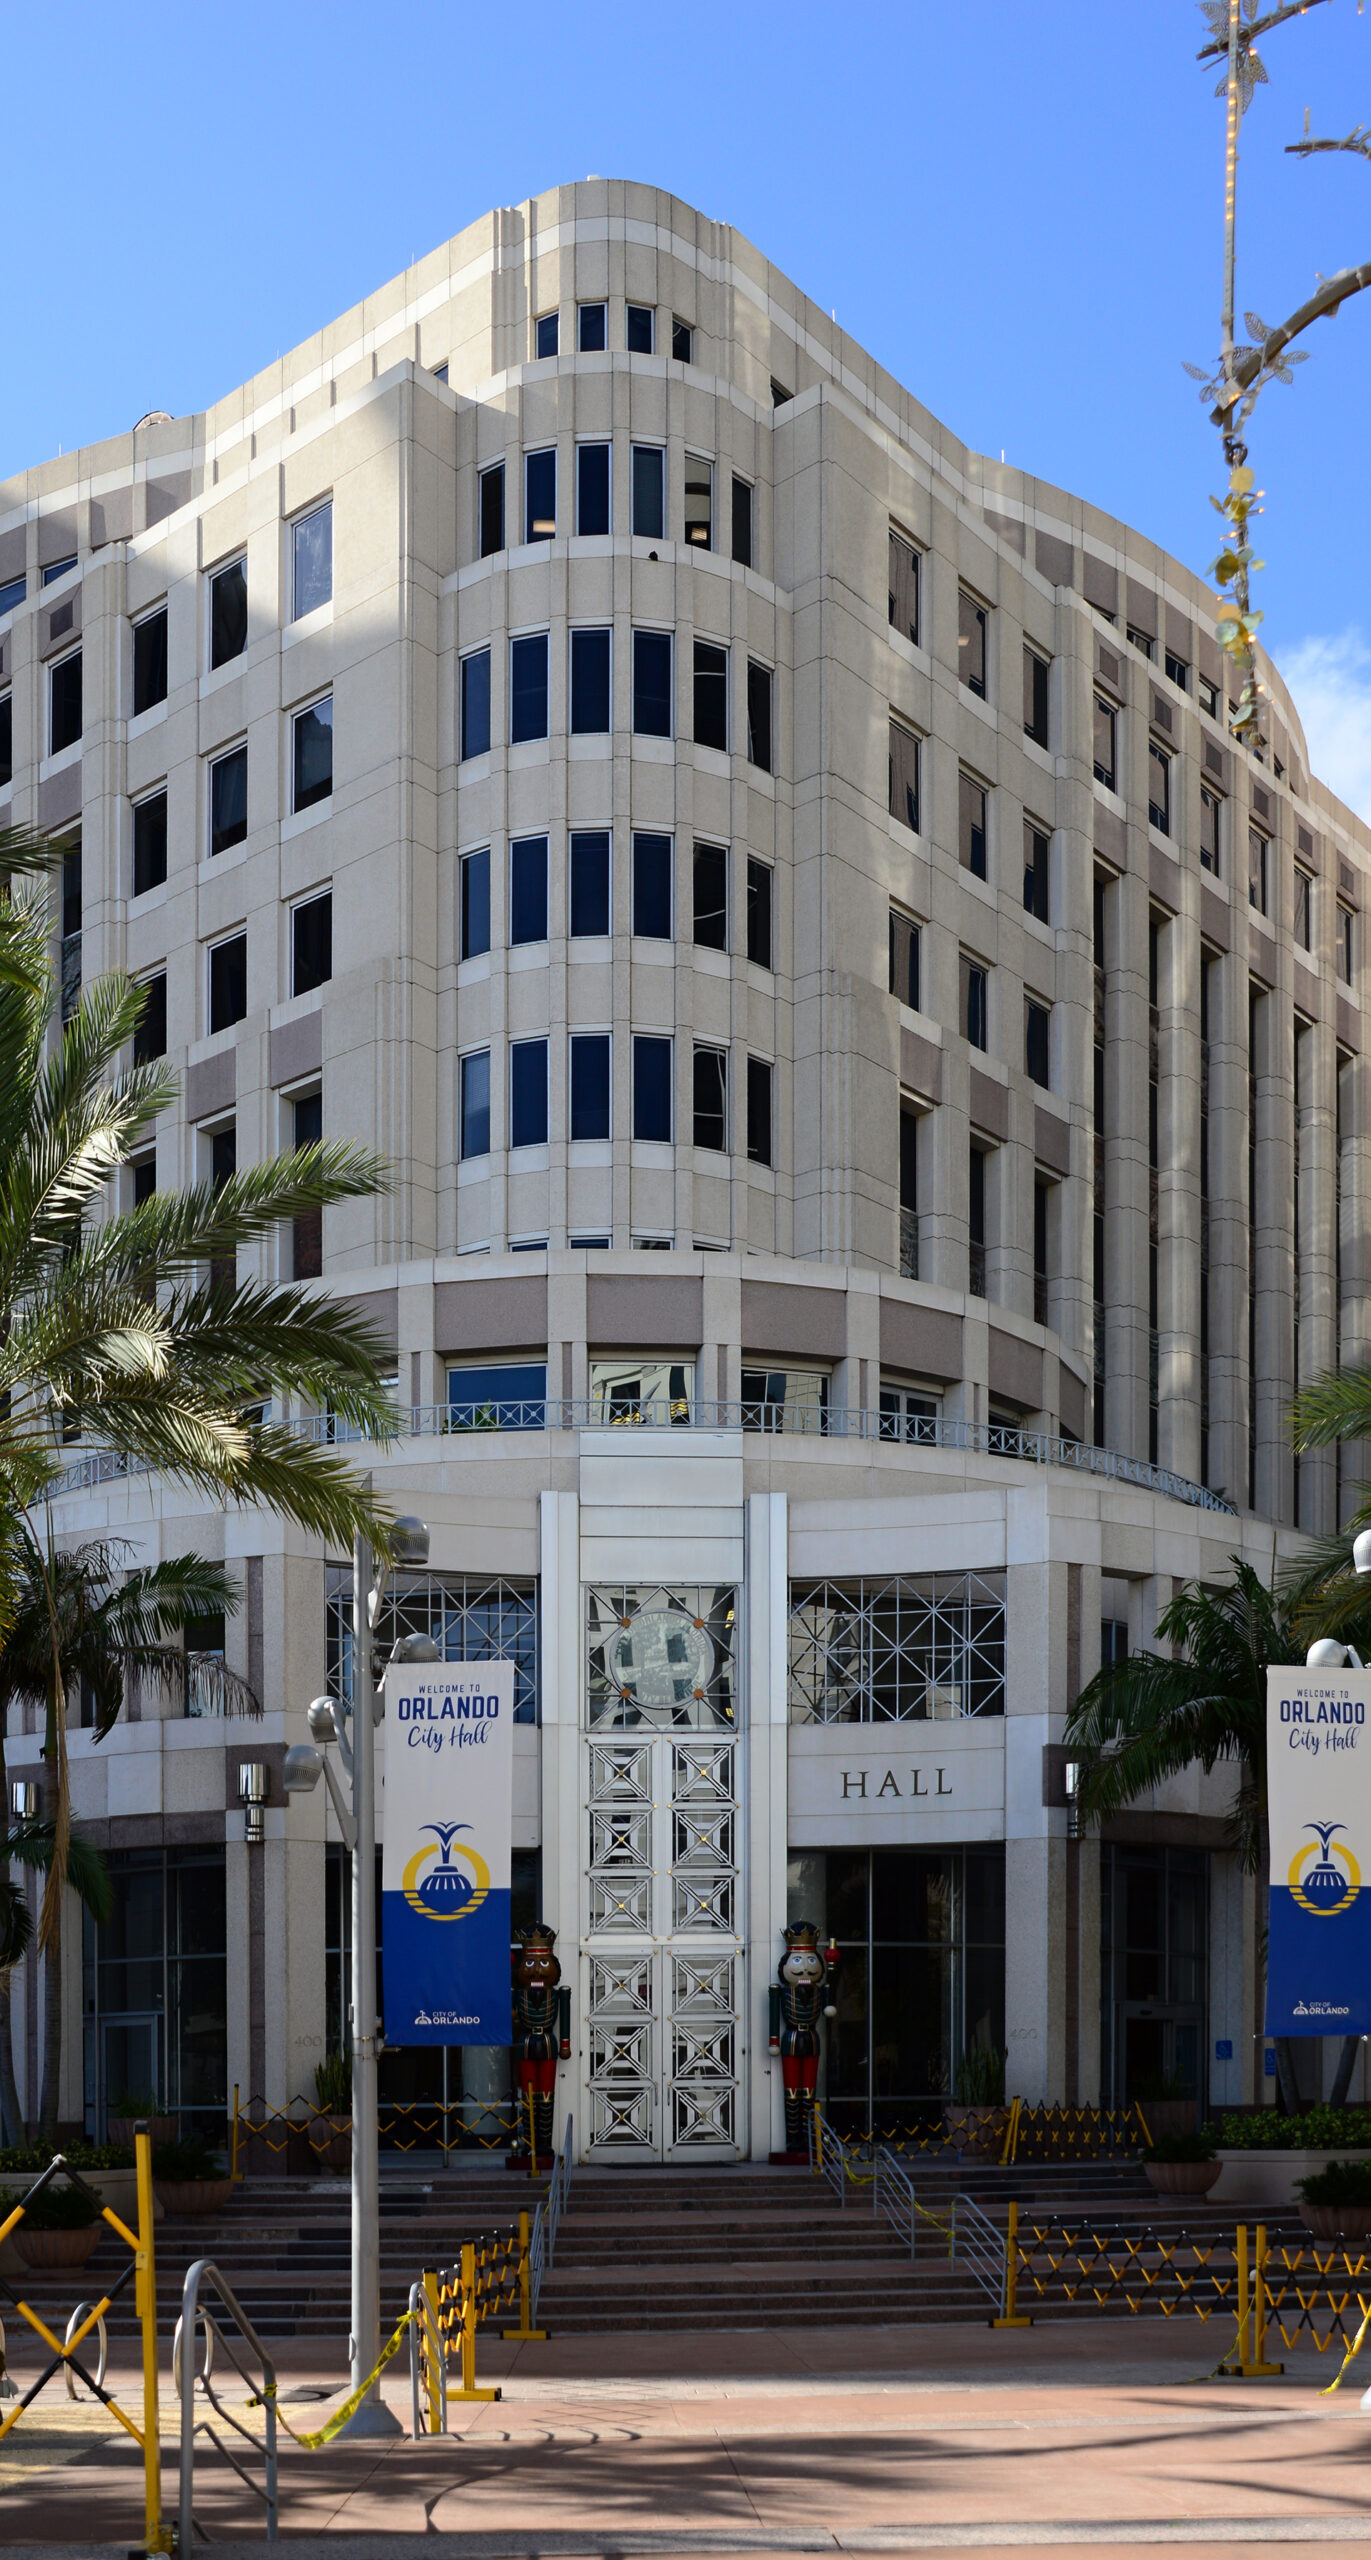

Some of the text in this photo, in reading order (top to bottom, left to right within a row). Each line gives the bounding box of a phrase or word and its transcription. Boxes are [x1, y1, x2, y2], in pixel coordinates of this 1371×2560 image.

[418, 1684, 480, 1694] WELCOME TO
[1297, 1689, 1349, 1699] WELCOME TO
[398, 1695, 499, 1720] ORLANDO
[1280, 1700, 1365, 1725] ORLANDO
[408, 1721, 493, 1753] City Hall
[1289, 1726, 1361, 1755] City Hall
[840, 1768, 953, 1799] HALL
[432, 2016, 481, 2025] ORLANDO
[1309, 2007, 1349, 2015] ORLANDO
[294, 2034, 322, 2048] 400
